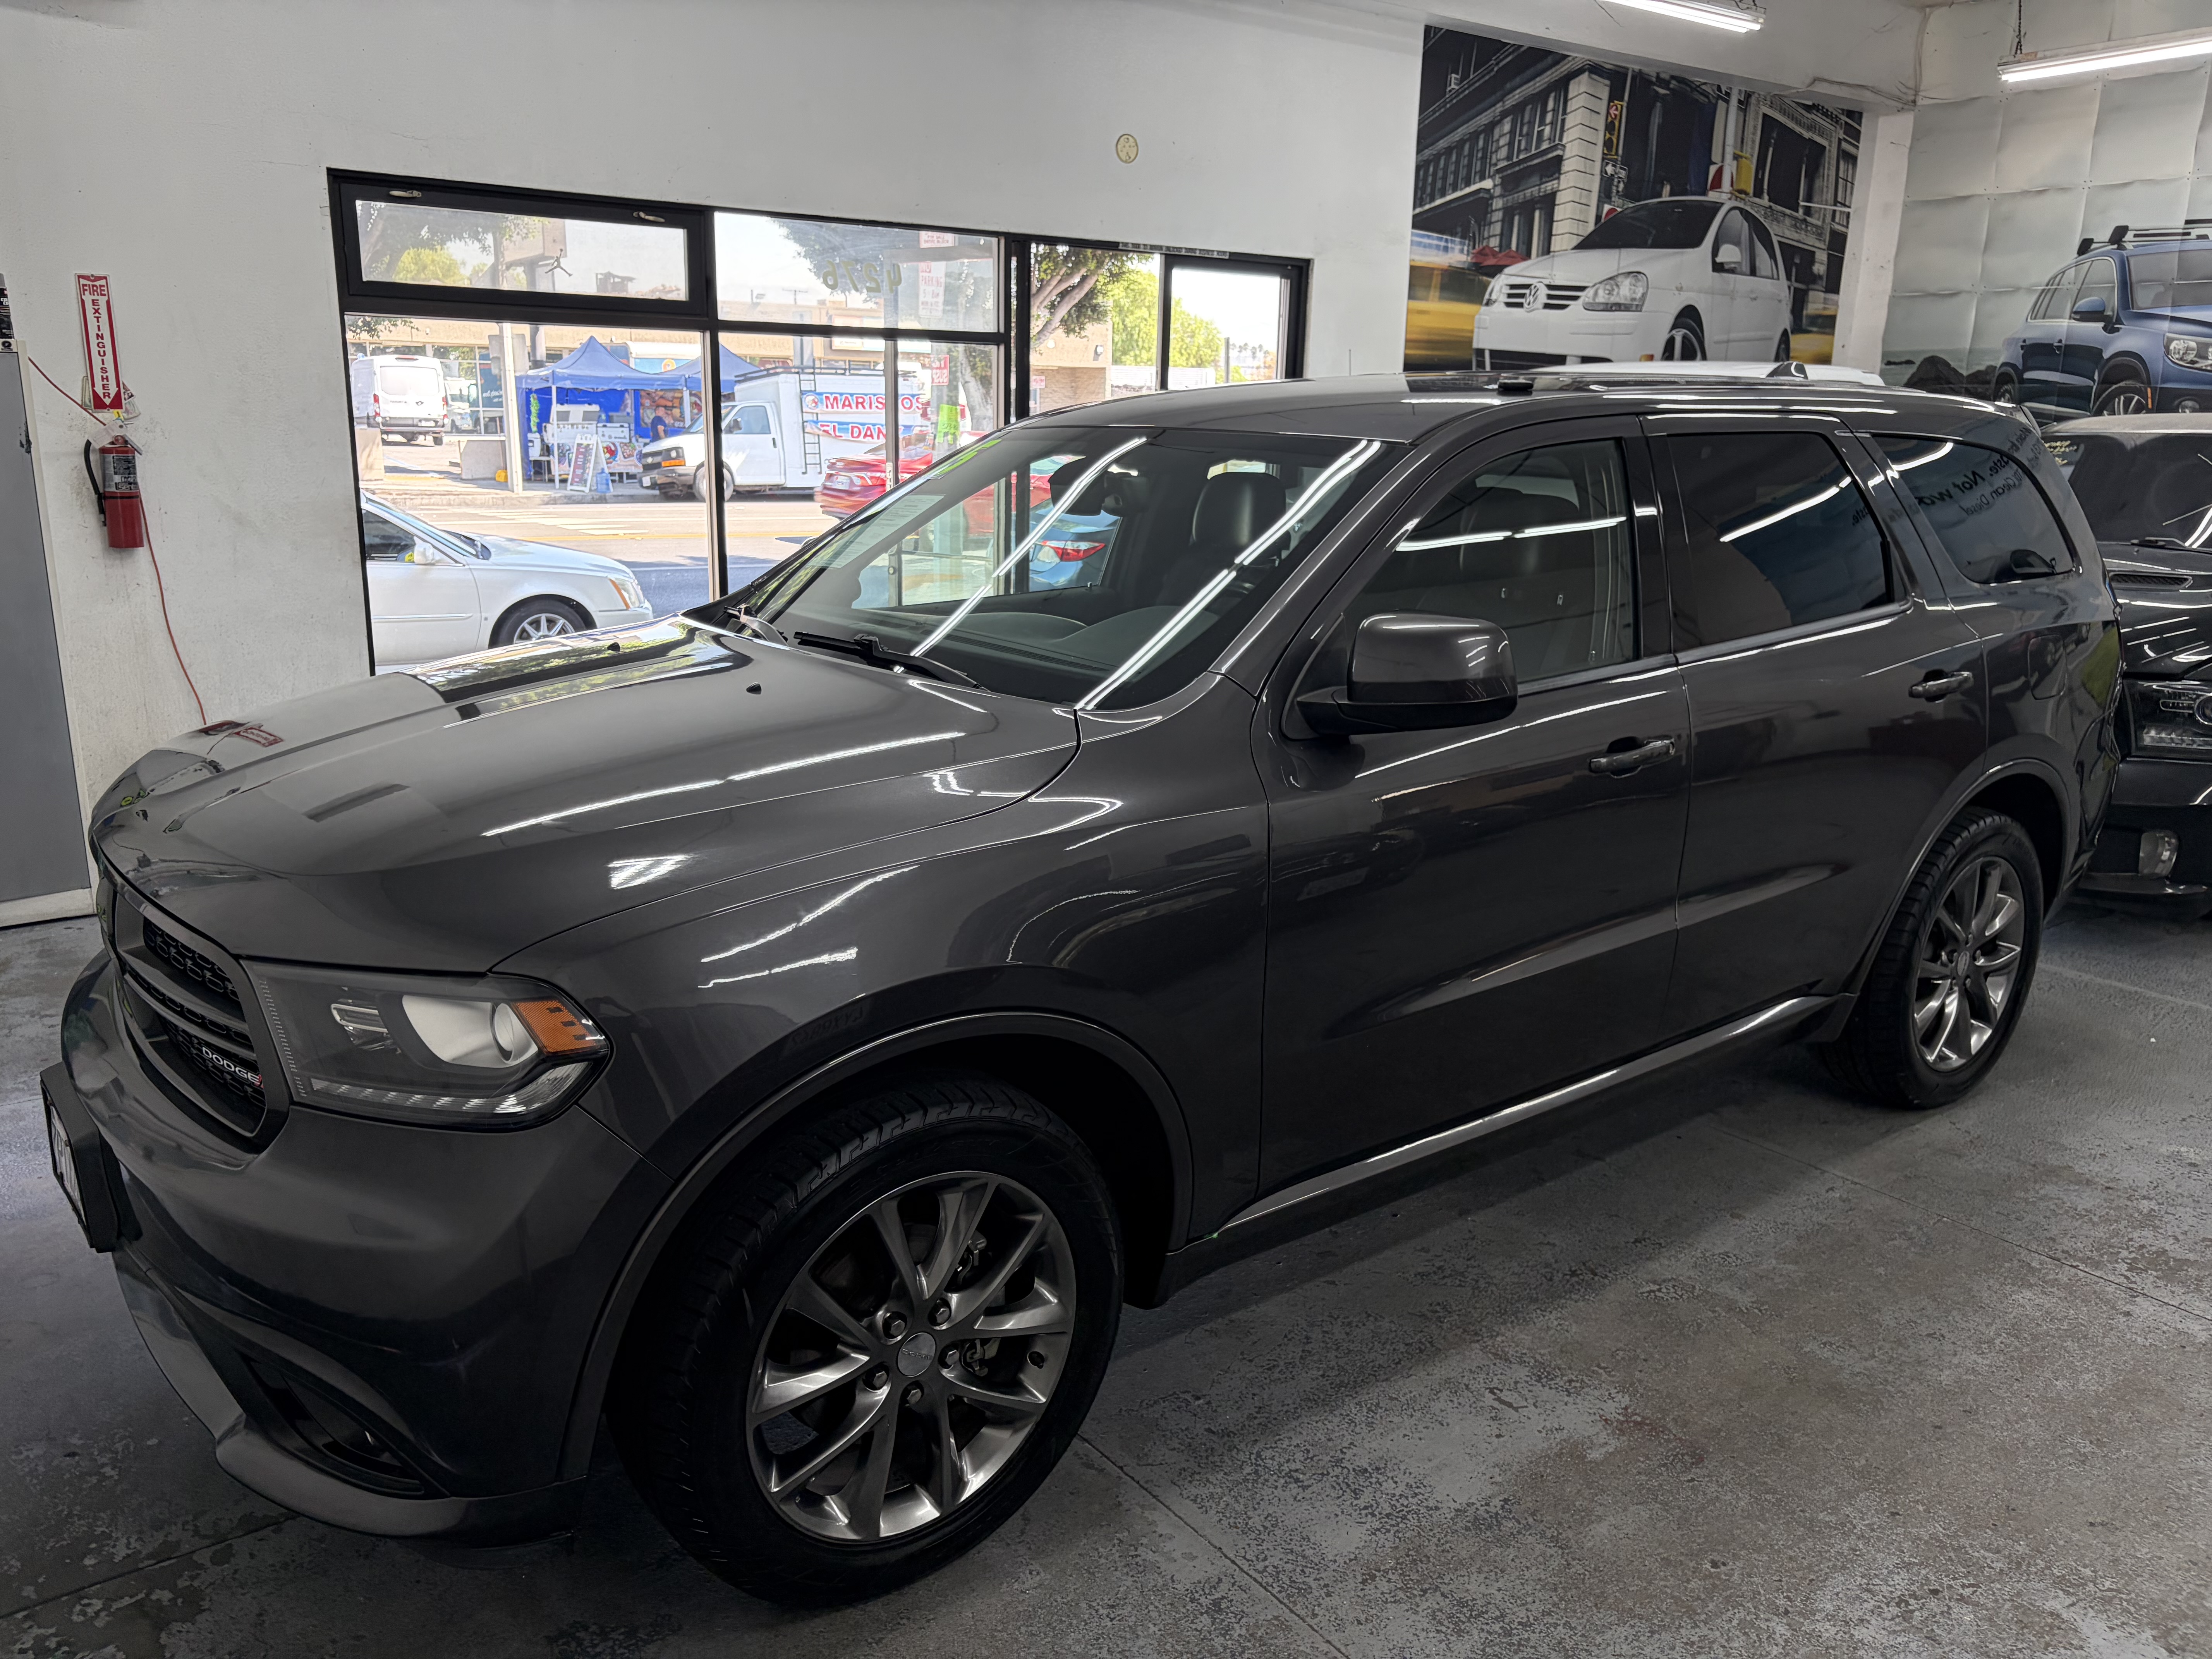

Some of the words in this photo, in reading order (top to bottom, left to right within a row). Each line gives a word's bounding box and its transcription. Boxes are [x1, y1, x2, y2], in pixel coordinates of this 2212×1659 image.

[81, 283, 106, 296] FIRE
[91, 299, 111, 399] EXTINGUISHER
[824, 395, 922, 410] MARISOS
[202, 1046, 260, 1085] DODGE
